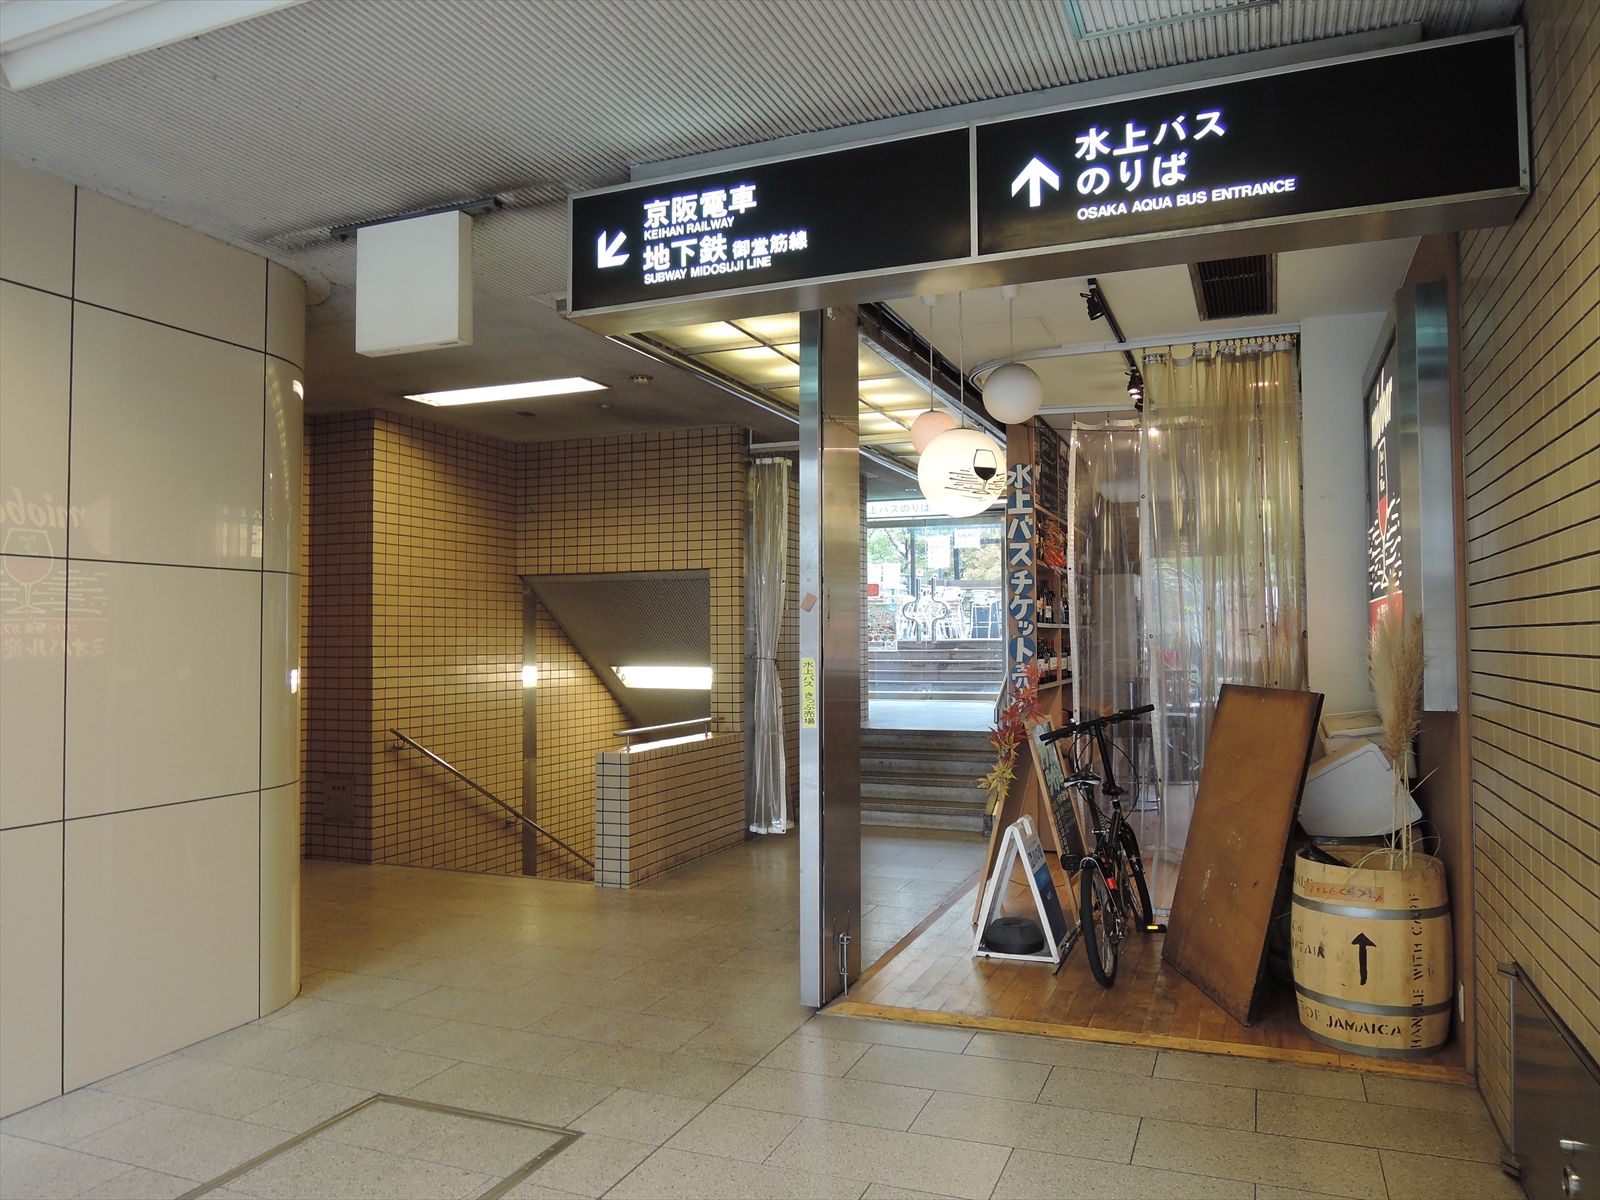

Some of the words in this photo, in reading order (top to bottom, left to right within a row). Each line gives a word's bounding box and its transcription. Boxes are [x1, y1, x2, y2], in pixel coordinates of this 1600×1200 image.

[1074, 108, 1226, 161] 水上バス
[1076, 151, 1188, 195] のりば
[643, 184, 757, 228] 京阪電車
[1077, 203, 1127, 221] OSAKA
[1131, 196, 1173, 213] AQUA
[1176, 191, 1207, 207] BUS
[1211, 178, 1296, 202] ENTRANCE
[644, 226, 684, 241] KEIHAN
[687, 216, 735, 235] RAILWAY
[643, 233, 727, 272] 地下鉄
[731, 230, 808, 259] 御堂筋線
[644, 269, 687, 285] SUBWAY
[690, 259, 744, 278] MIDOSUJI
[746, 256, 772, 270] LINE
[1005, 464, 1034, 704] 水上バスチケット売
[803, 661, 814, 687] 水上バス
[1412, 943, 1424, 981] WITH
[1326, 1015, 1402, 1036] JAMAICA
